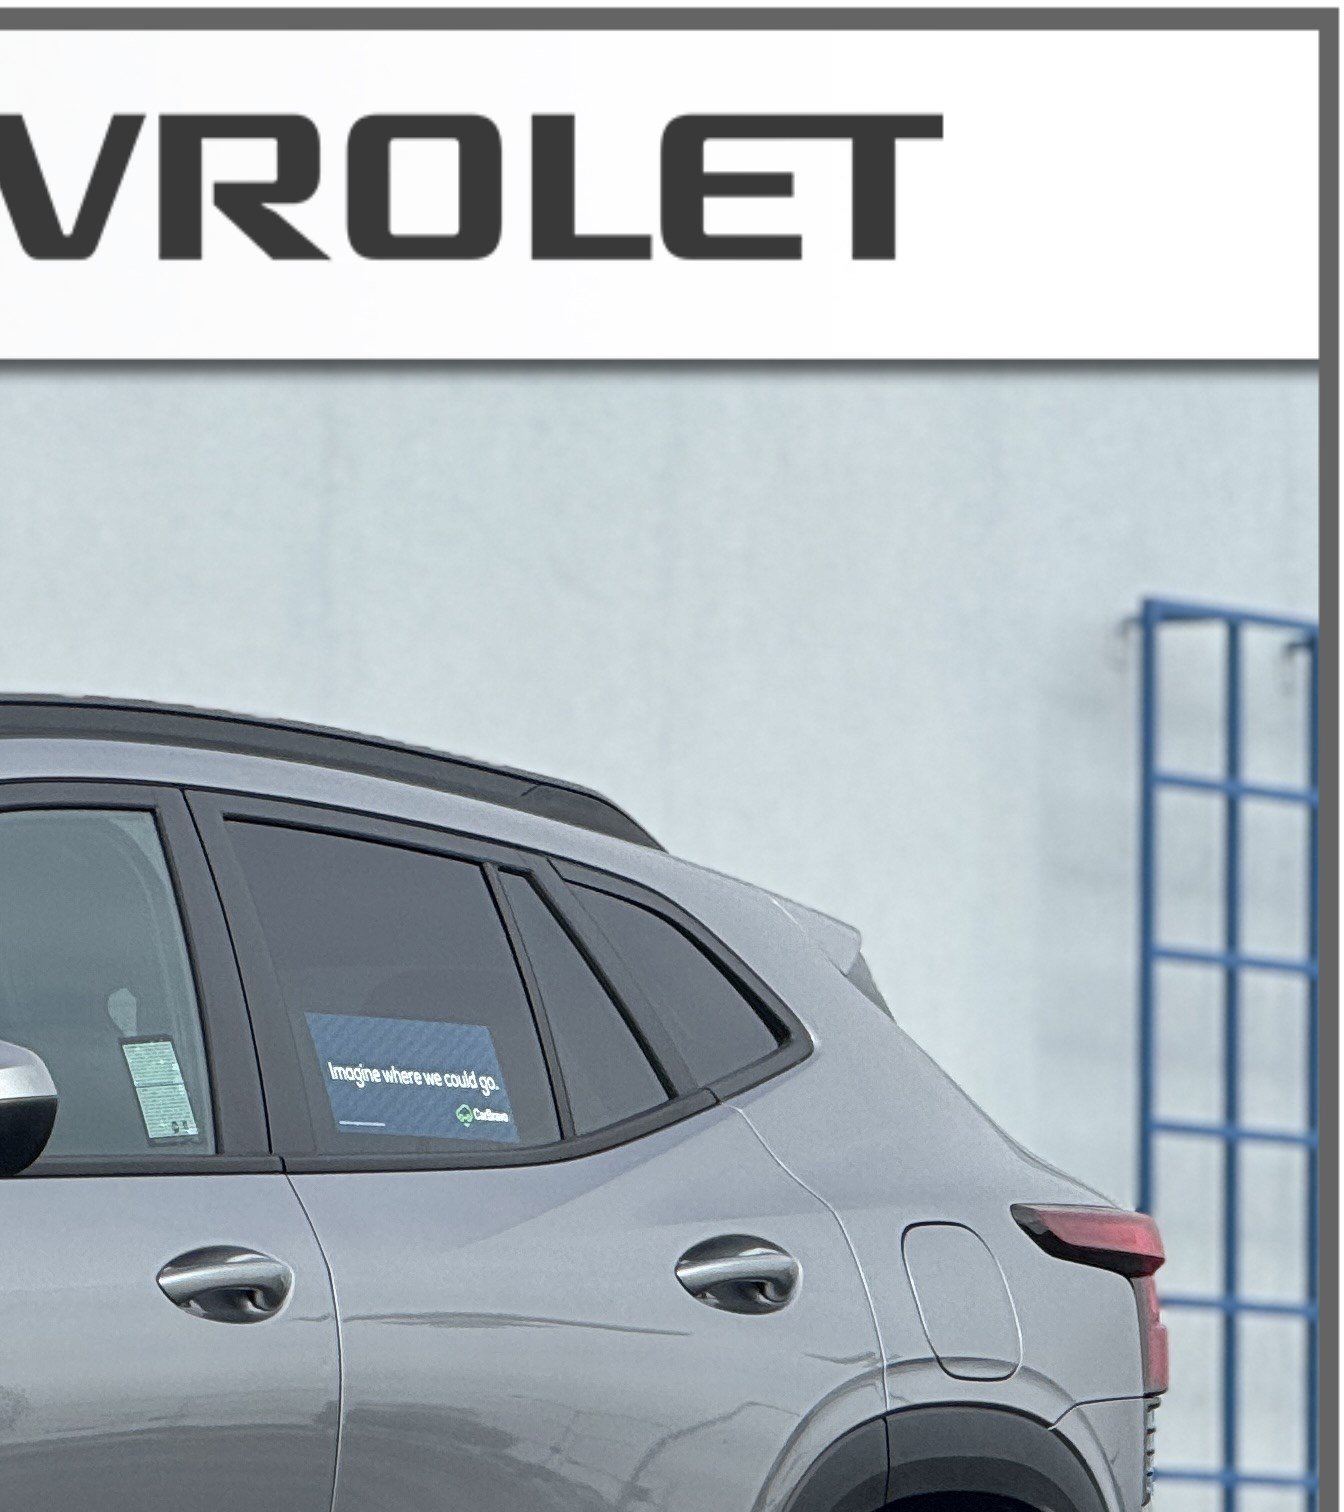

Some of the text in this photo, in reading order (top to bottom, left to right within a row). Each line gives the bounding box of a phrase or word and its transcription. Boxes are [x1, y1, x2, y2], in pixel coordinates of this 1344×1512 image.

[327, 1062, 500, 1096] Imagine where we could go.
